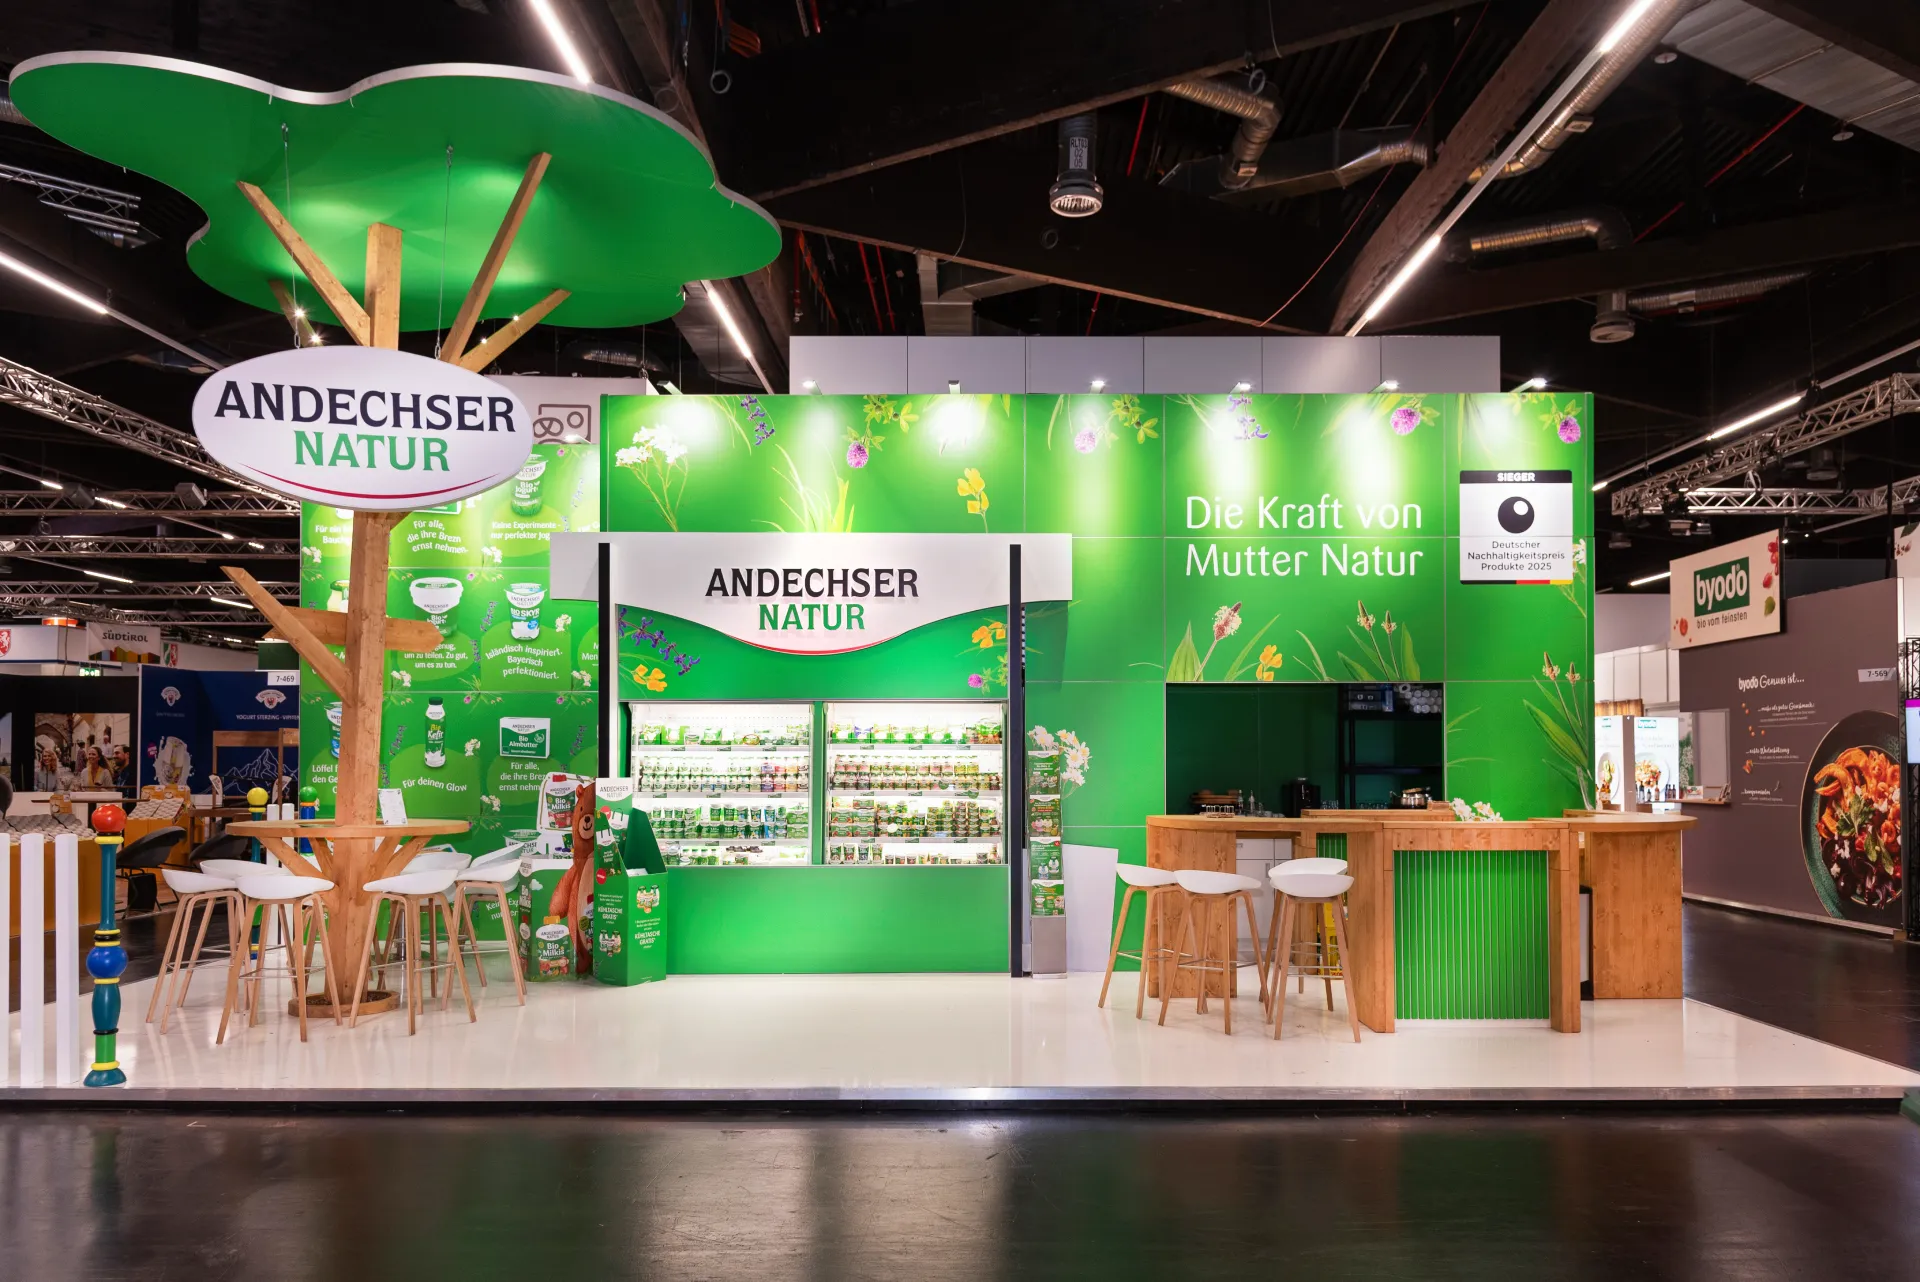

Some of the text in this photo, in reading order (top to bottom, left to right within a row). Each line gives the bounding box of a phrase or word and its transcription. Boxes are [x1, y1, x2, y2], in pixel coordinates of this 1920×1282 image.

[214, 380, 516, 432] ANDECHSER
[294, 430, 450, 471] NATUR
[1497, 472, 1535, 482] SIEGER
[1186, 494, 1422, 529] Die Kraft von
[413, 520, 445, 530] Für alle,
[513, 522, 557, 530] Experimente
[407, 530, 461, 543] die ihre Brezn
[504, 532, 537, 540] perfekter
[412, 542, 433, 552] ernst
[1492, 541, 1541, 549] Deutscher
[1185, 543, 1423, 577] Mutter Natur
[1467, 552, 1566, 561] Nachhaltigkeitspreis
[705, 568, 919, 597] ANDECHSER
[758, 604, 865, 630] NATUR
[1697, 612, 1748, 629] bio vom feinsten
[485, 644, 563, 660] Isländisch inspiriert.
[507, 655, 543, 667] Bayerisch
[502, 666, 559, 679] perfektioniert.
[1738, 676, 1758, 692] byodo
[1760, 675, 1786, 688] Genuss
[428, 730, 444, 738] Kefir
[524, 762, 540, 770] alle,
[402, 777, 467, 791] Für deinen Glow
[542, 949, 564, 957] Milkis
